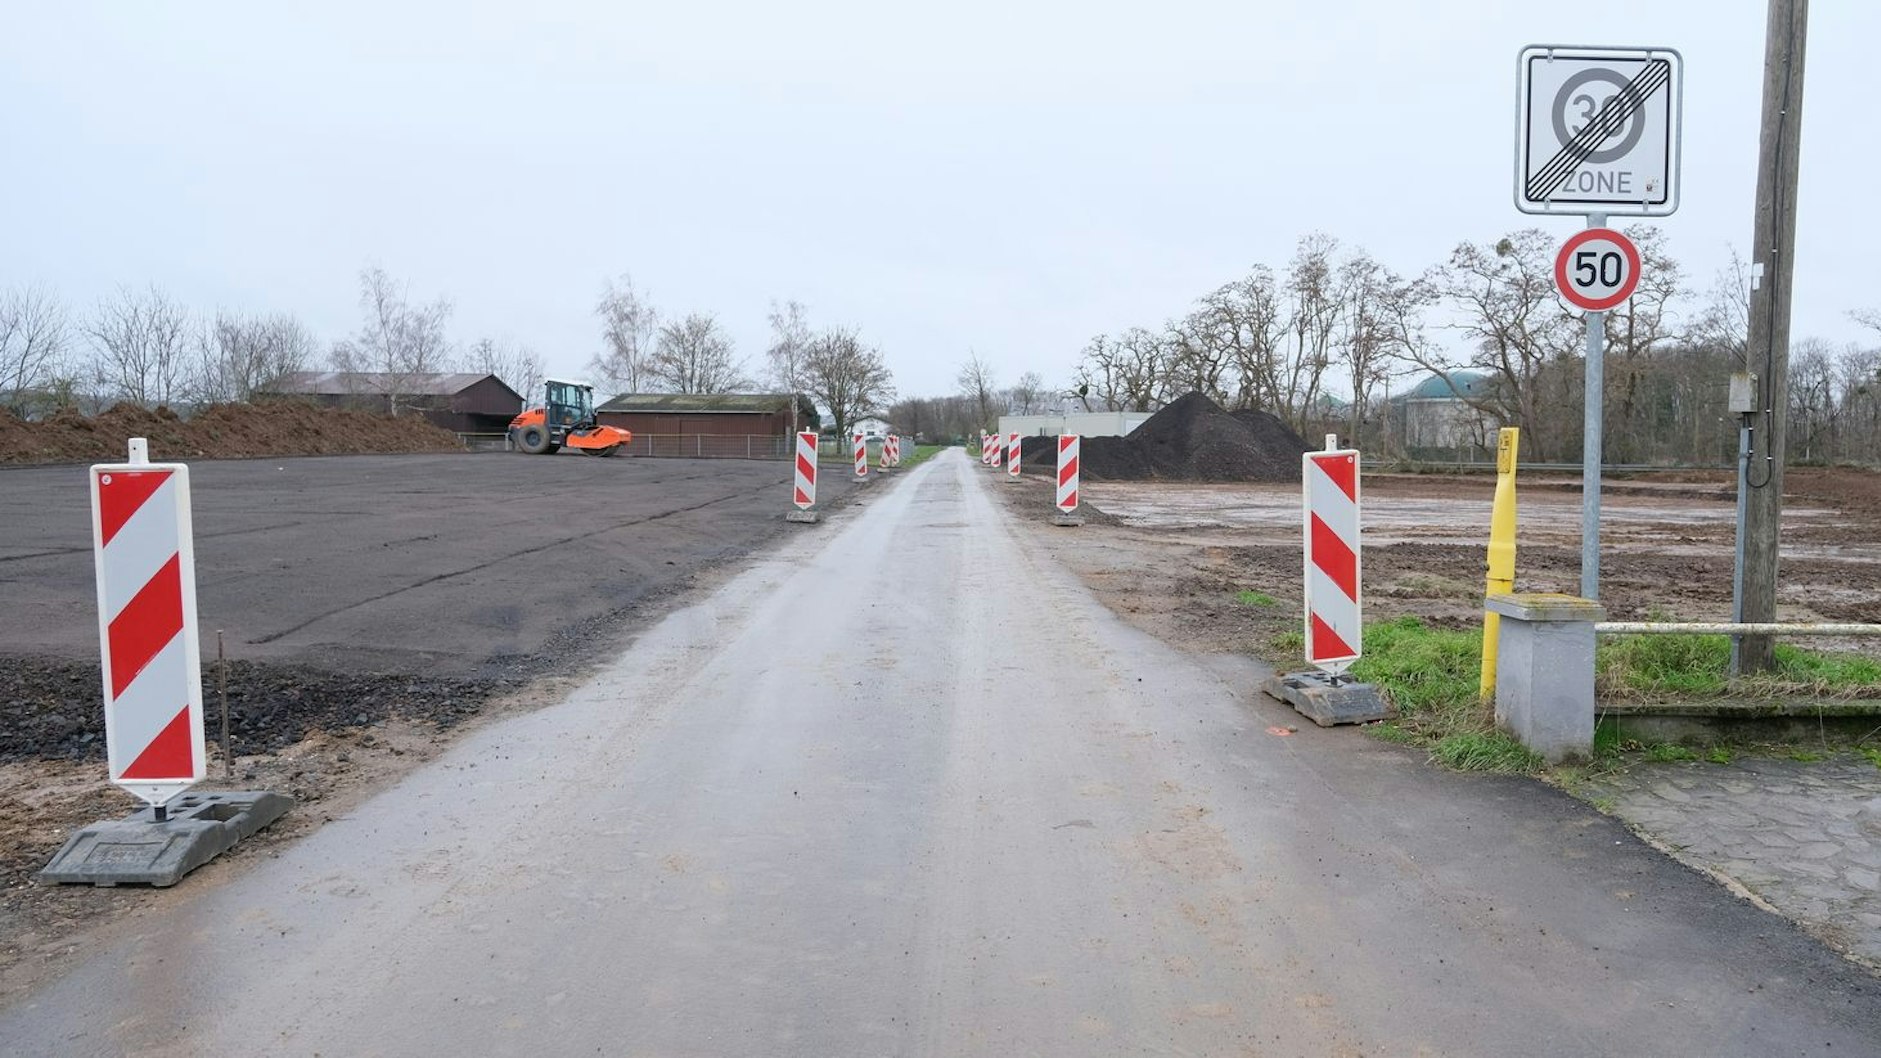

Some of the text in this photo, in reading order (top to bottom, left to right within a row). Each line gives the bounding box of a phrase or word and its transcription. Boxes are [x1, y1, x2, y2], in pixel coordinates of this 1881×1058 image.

[1572, 94, 1625, 138] 30
[1561, 170, 1632, 194] ZONE
[1575, 251, 1623, 288] 50
